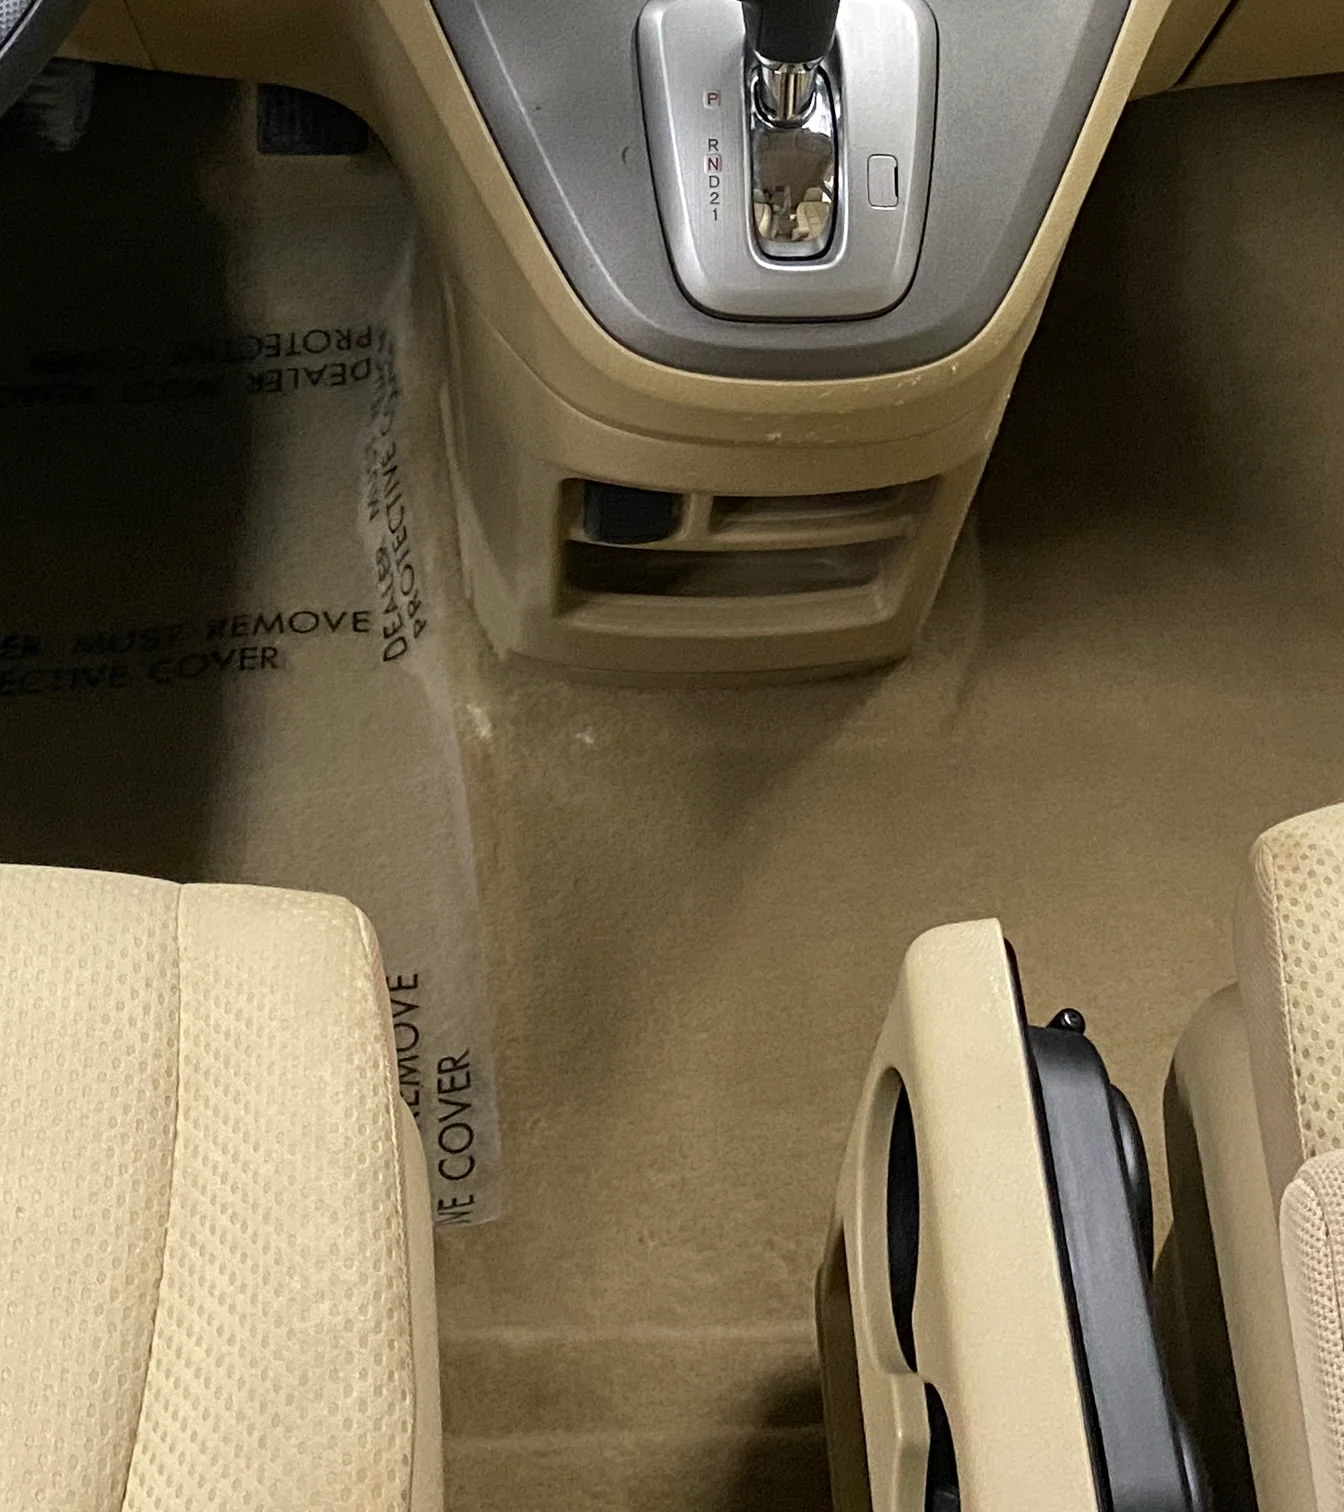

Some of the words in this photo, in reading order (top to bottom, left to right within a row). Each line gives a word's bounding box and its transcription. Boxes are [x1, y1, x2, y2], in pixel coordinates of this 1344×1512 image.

[707, 93, 718, 105] P
[708, 139, 719, 152] R
[708, 158, 719, 171] N
[709, 175, 720, 188] D
[709, 192, 720, 205] 2
[712, 208, 719, 221] 1
[246, 361, 373, 394] DEALER
[206, 610, 371, 641] REMOVE
[149, 646, 278, 683] COVER
[386, 973, 420, 1120] EMOVE
[437, 1048, 476, 1181] COVER
